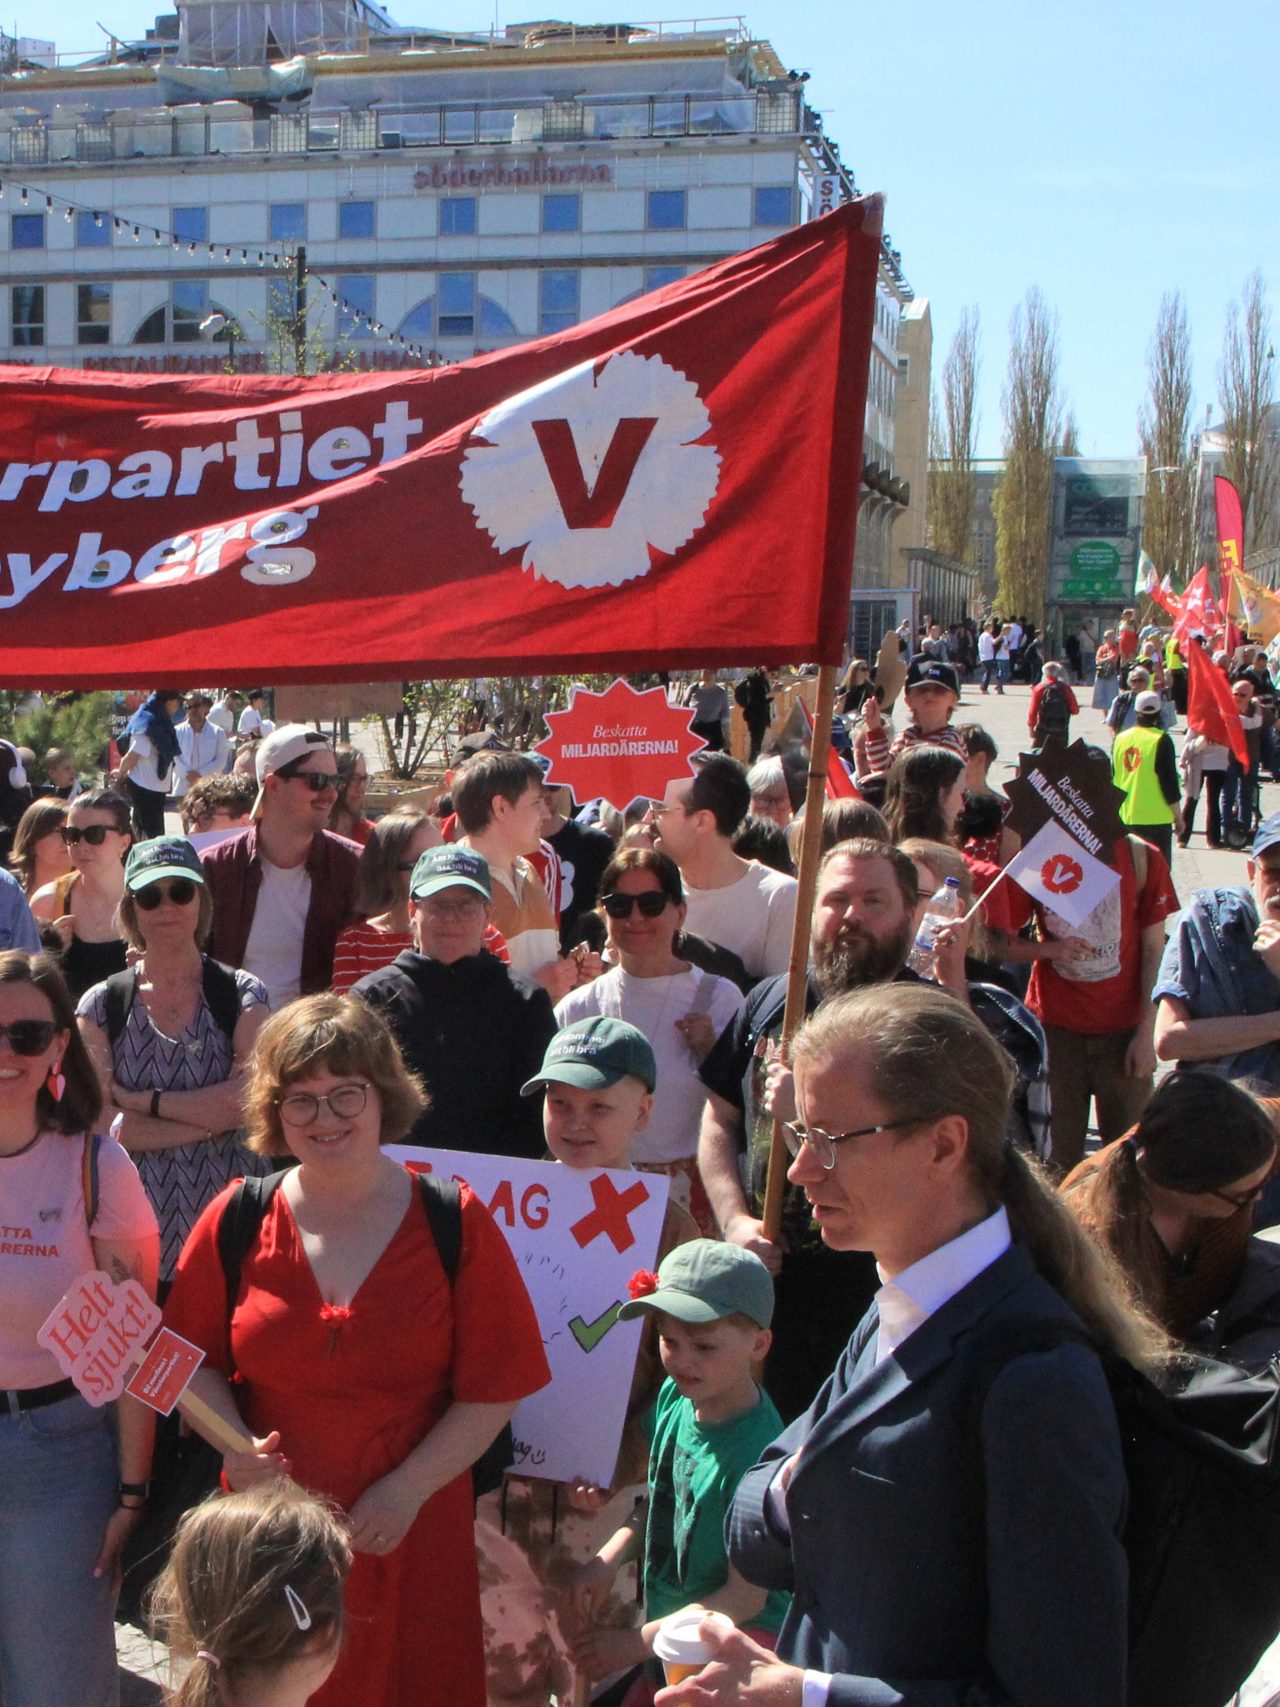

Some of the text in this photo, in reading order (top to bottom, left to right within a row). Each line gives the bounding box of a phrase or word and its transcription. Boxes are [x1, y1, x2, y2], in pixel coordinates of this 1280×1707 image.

[531, 417, 659, 530] V
[561, 739, 679, 758] MILJARDÄRERNA!
[593, 724, 647, 738] Beskatta
[1027, 768, 1104, 855] MILJARDÄRERNA!
[1057, 775, 1095, 818] Beskatta
[1051, 864, 1075, 885] V
[49, 1281, 115, 1363] Helt
[82, 1289, 153, 1397] sjukt!
